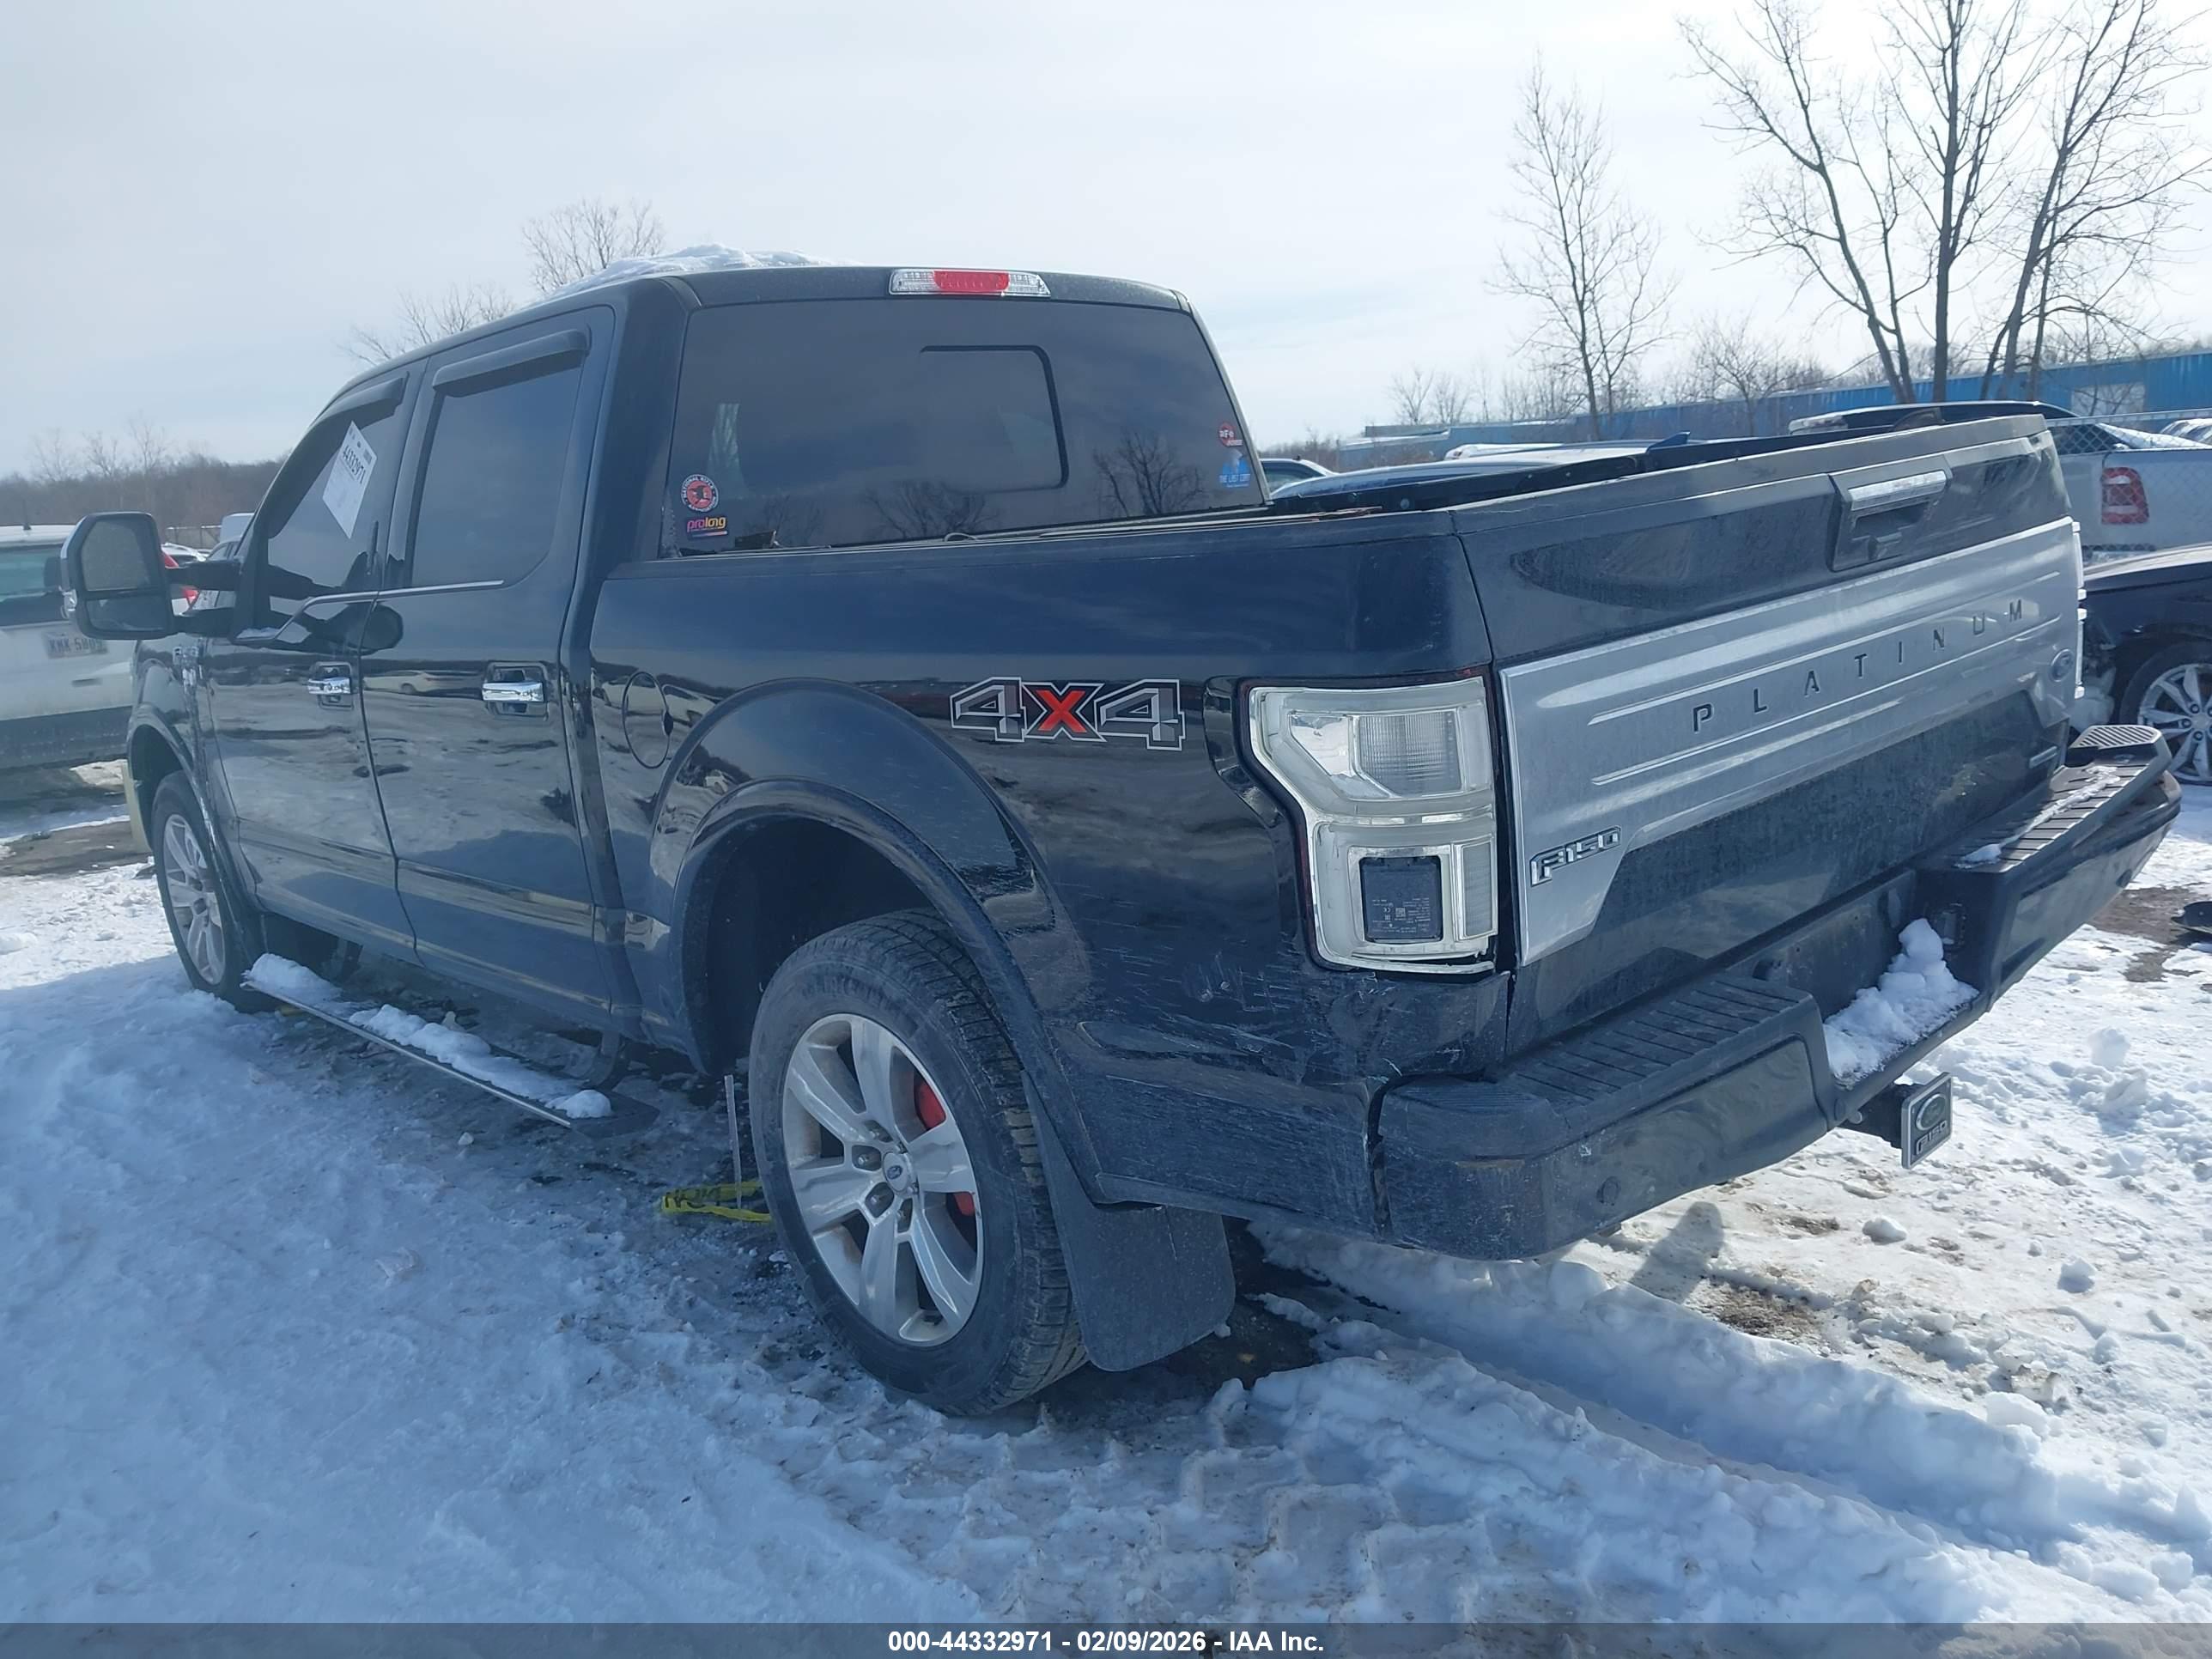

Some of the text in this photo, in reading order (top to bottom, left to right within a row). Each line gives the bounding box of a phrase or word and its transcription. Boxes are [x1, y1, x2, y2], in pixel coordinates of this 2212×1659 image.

[343, 444, 367, 484] 44332971
[687, 517, 726, 532] prolong
[1692, 599, 2023, 733] PLATINUM
